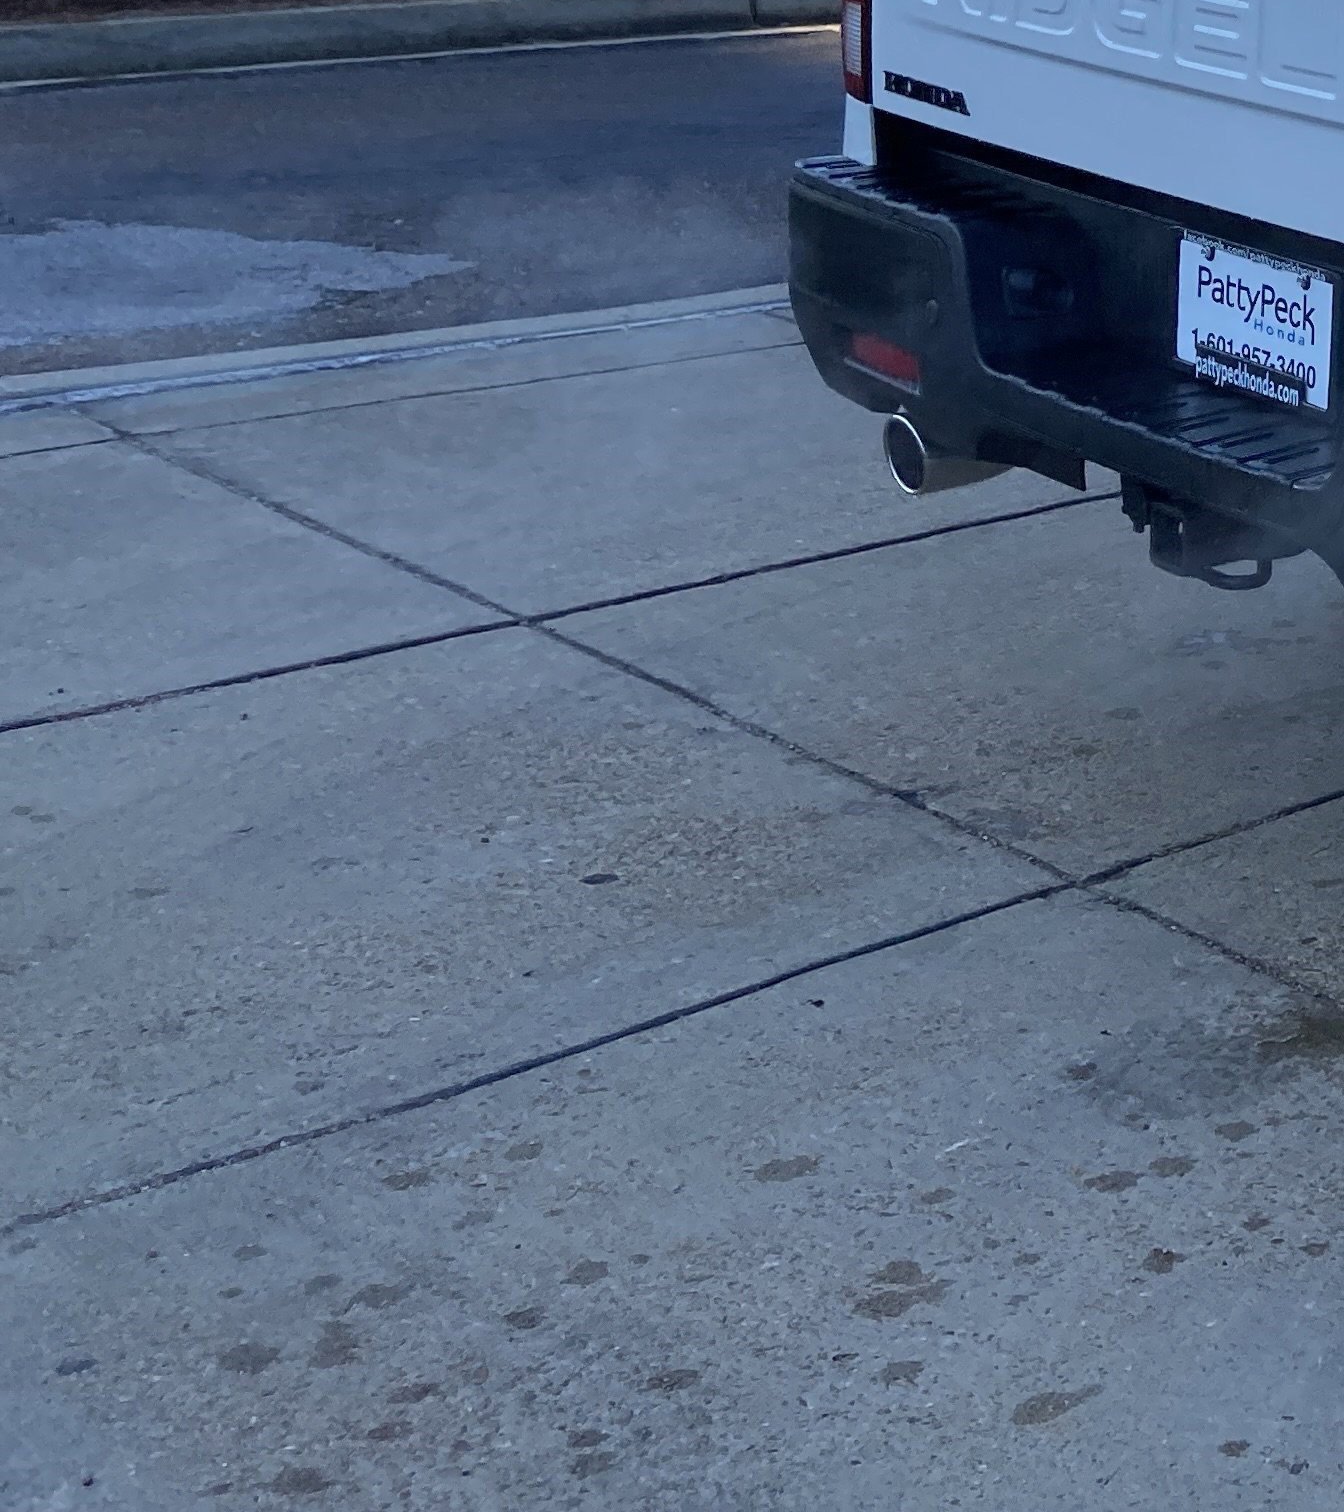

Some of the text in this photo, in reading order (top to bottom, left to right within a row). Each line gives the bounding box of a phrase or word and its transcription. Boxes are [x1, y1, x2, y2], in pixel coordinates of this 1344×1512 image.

[882, 70, 971, 117] HONDA
[1197, 264, 1316, 346] PattyPeck
[1191, 327, 1316, 389] 1-601-957-3400
[1253, 318, 1306, 347] Honda
[1194, 353, 1300, 407] pattypeckhonda.com
